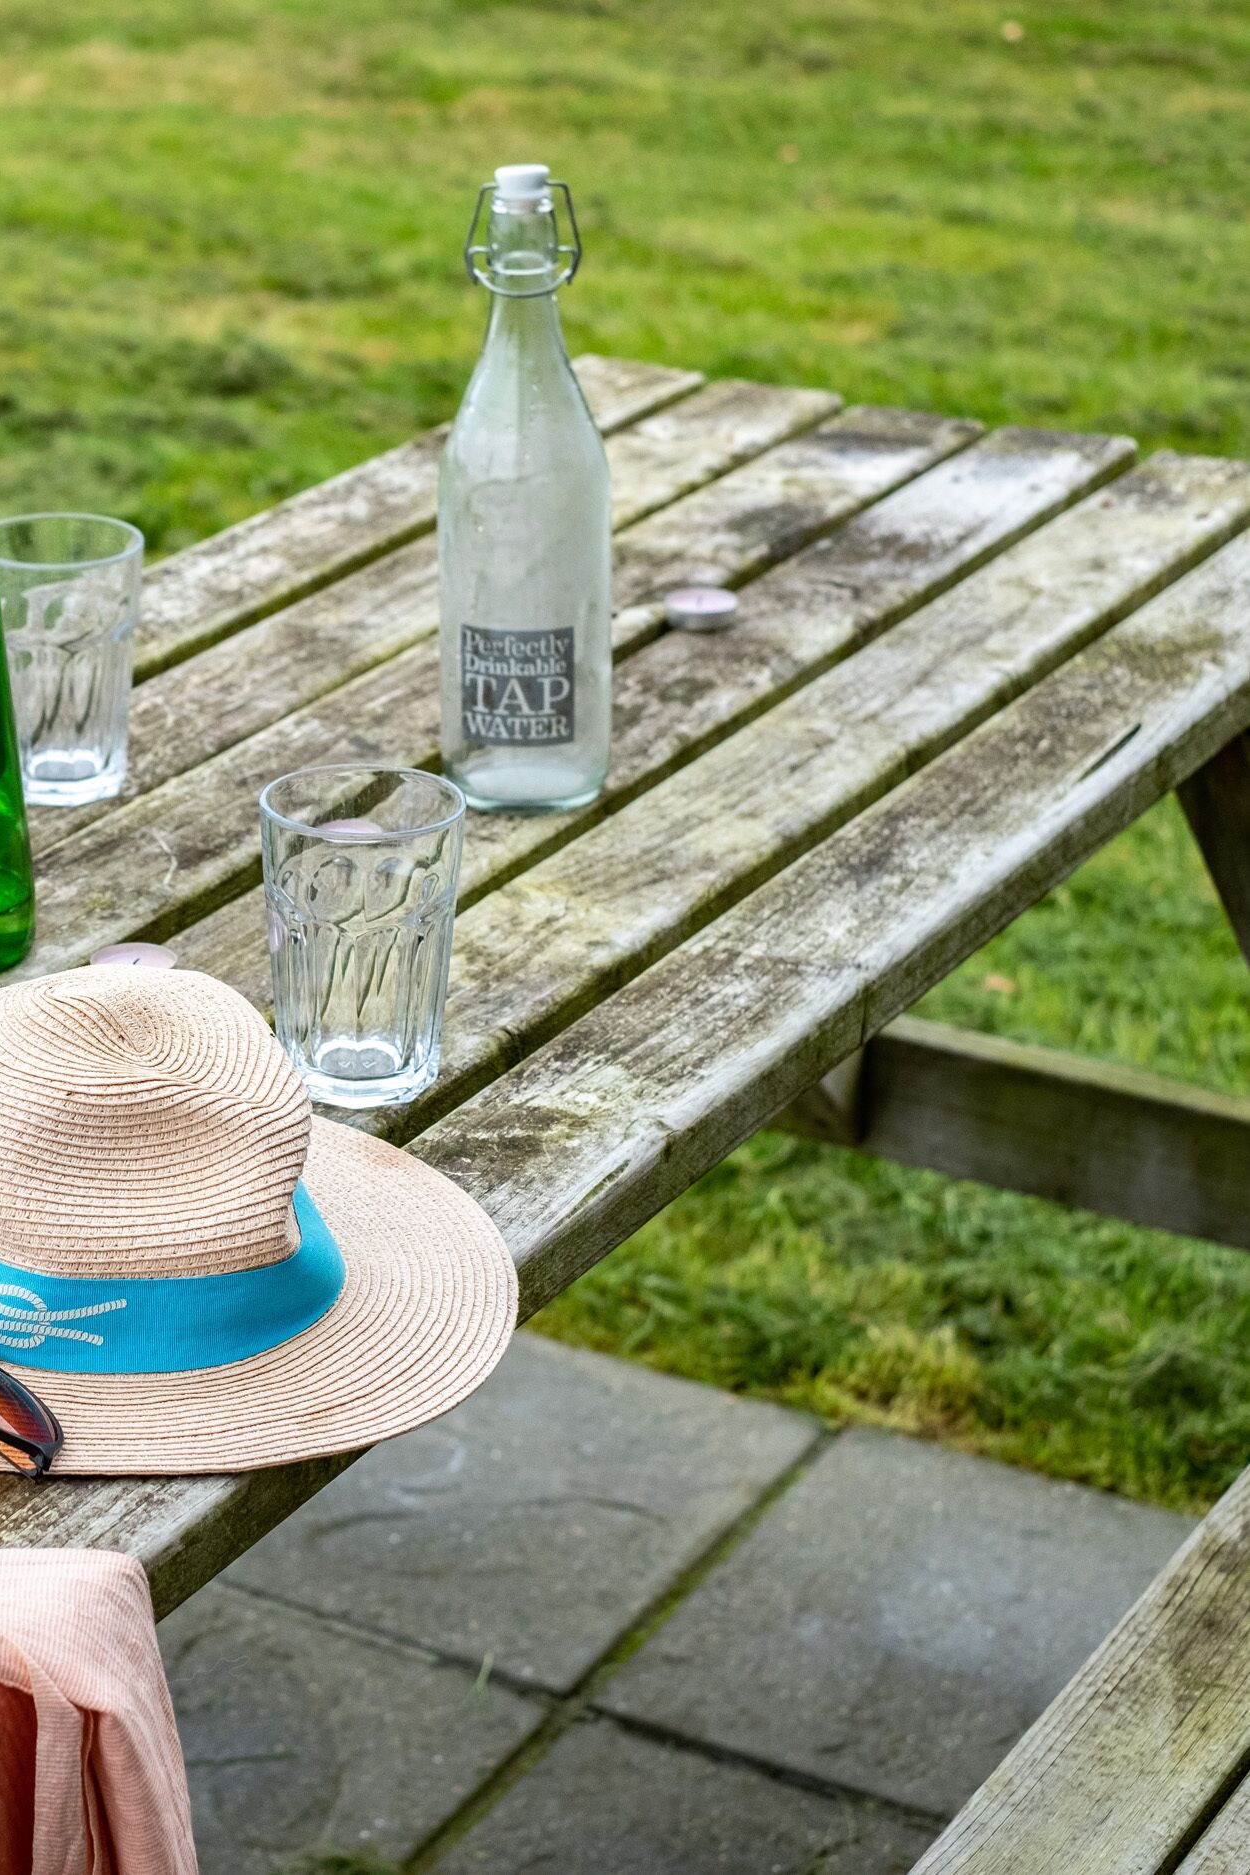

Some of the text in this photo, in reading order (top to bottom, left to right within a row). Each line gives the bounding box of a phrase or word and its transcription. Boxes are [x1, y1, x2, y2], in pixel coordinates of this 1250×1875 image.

[463, 629, 570, 659] Perfectly
[464, 652, 568, 676] Drinkable
[464, 672, 571, 716] TAP
[464, 711, 570, 740] WATER
